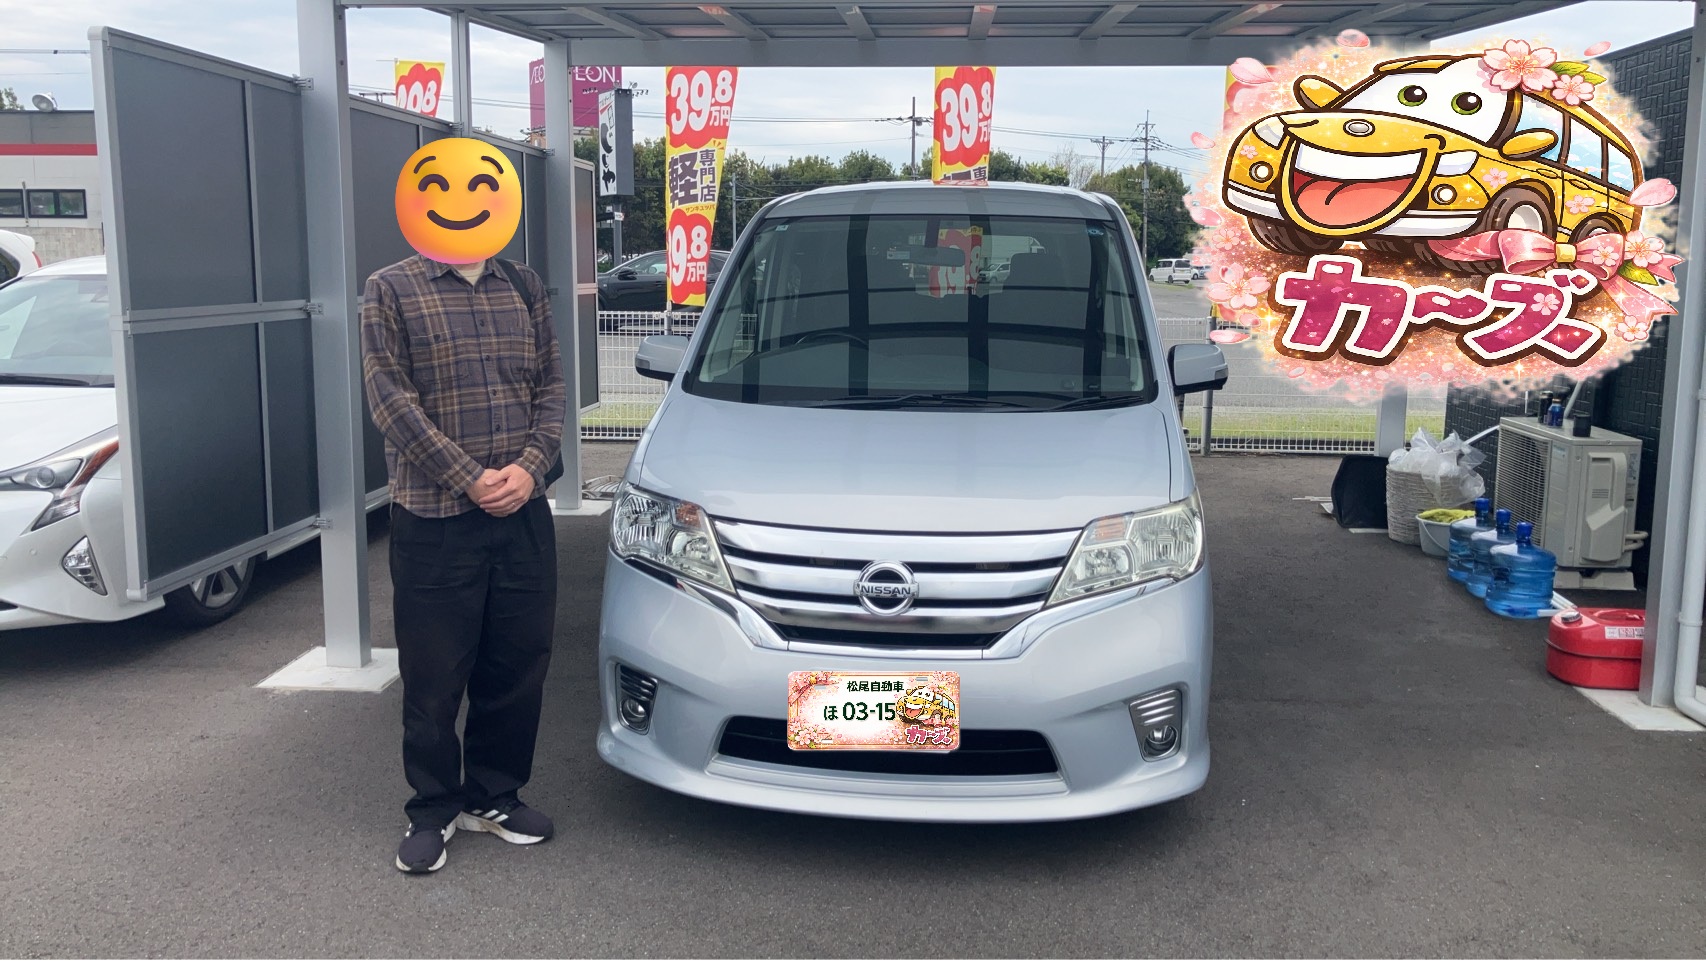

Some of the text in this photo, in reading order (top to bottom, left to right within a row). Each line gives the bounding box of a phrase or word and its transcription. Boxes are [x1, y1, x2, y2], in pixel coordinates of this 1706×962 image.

[671, 70, 733, 135] 39.8
[709, 105, 731, 127] 万円
[941, 81, 991, 152] 39.8
[669, 151, 699, 209] 軽
[699, 149, 717, 203] 専門店
[687, 261, 707, 283] 万円
[861, 585, 911, 595] NISSAN
